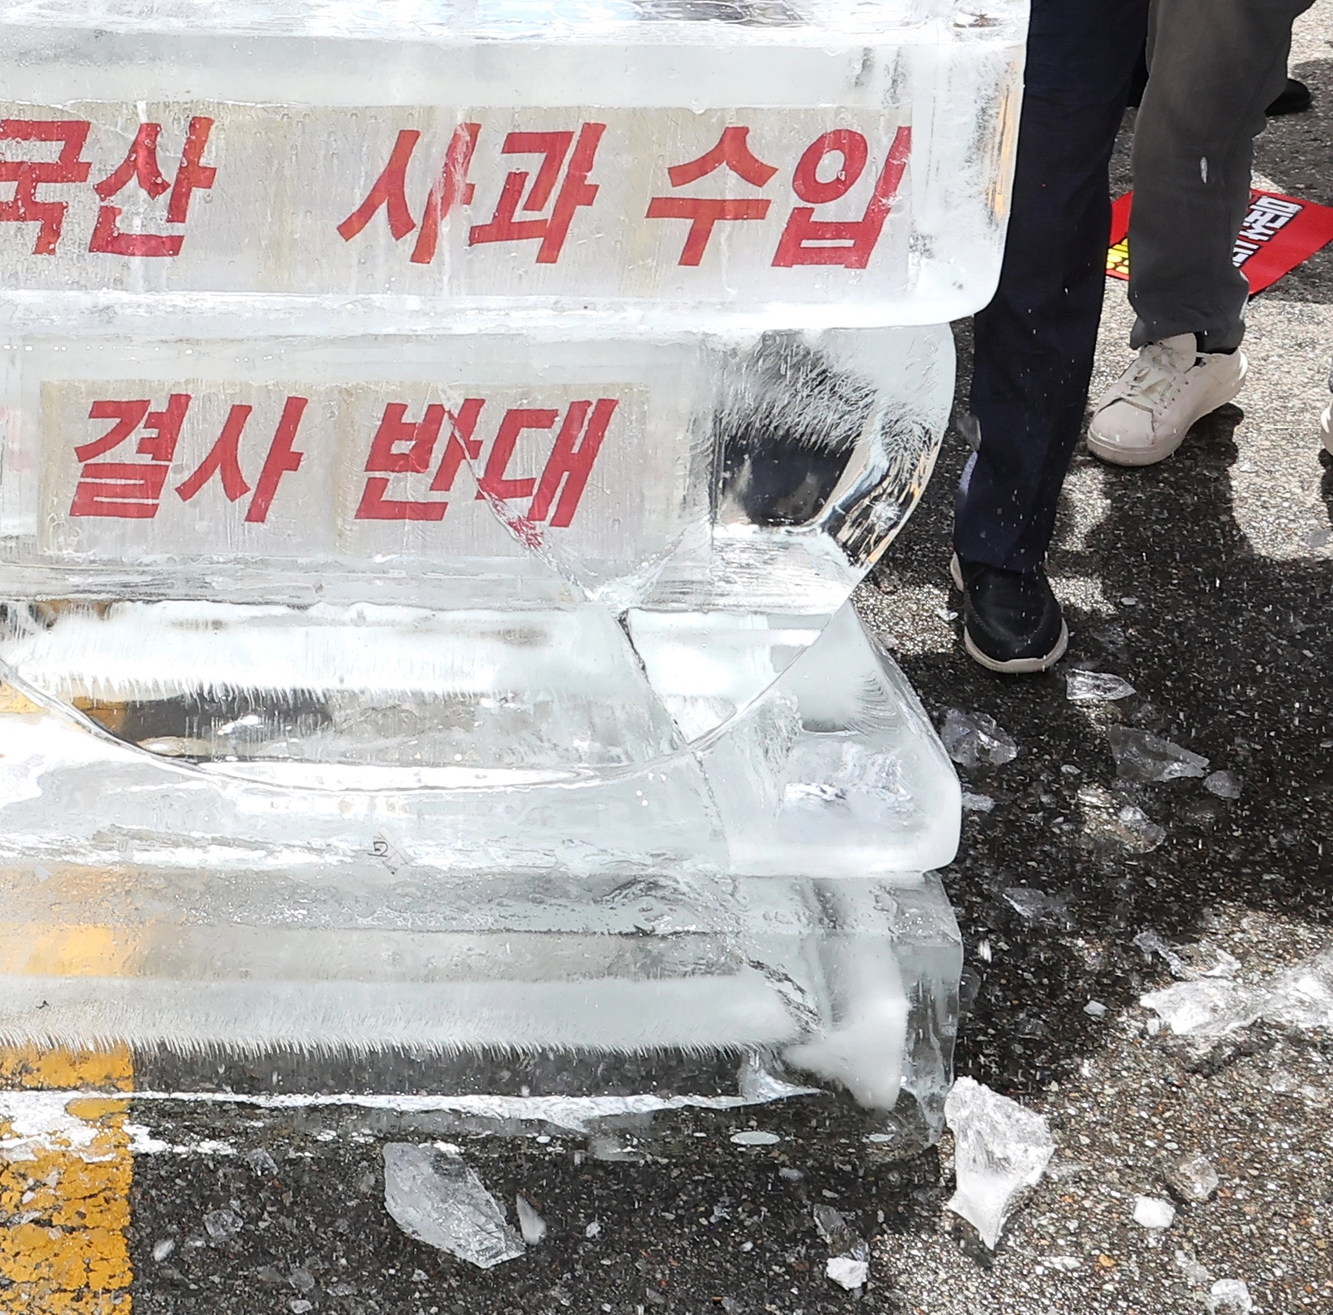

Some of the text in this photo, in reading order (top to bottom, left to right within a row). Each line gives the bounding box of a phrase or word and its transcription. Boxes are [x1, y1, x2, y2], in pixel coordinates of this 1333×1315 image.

[336, 122, 607, 266] 사과
[643, 125, 913, 271] 수입
[67, 391, 619, 531] 결사 반대
